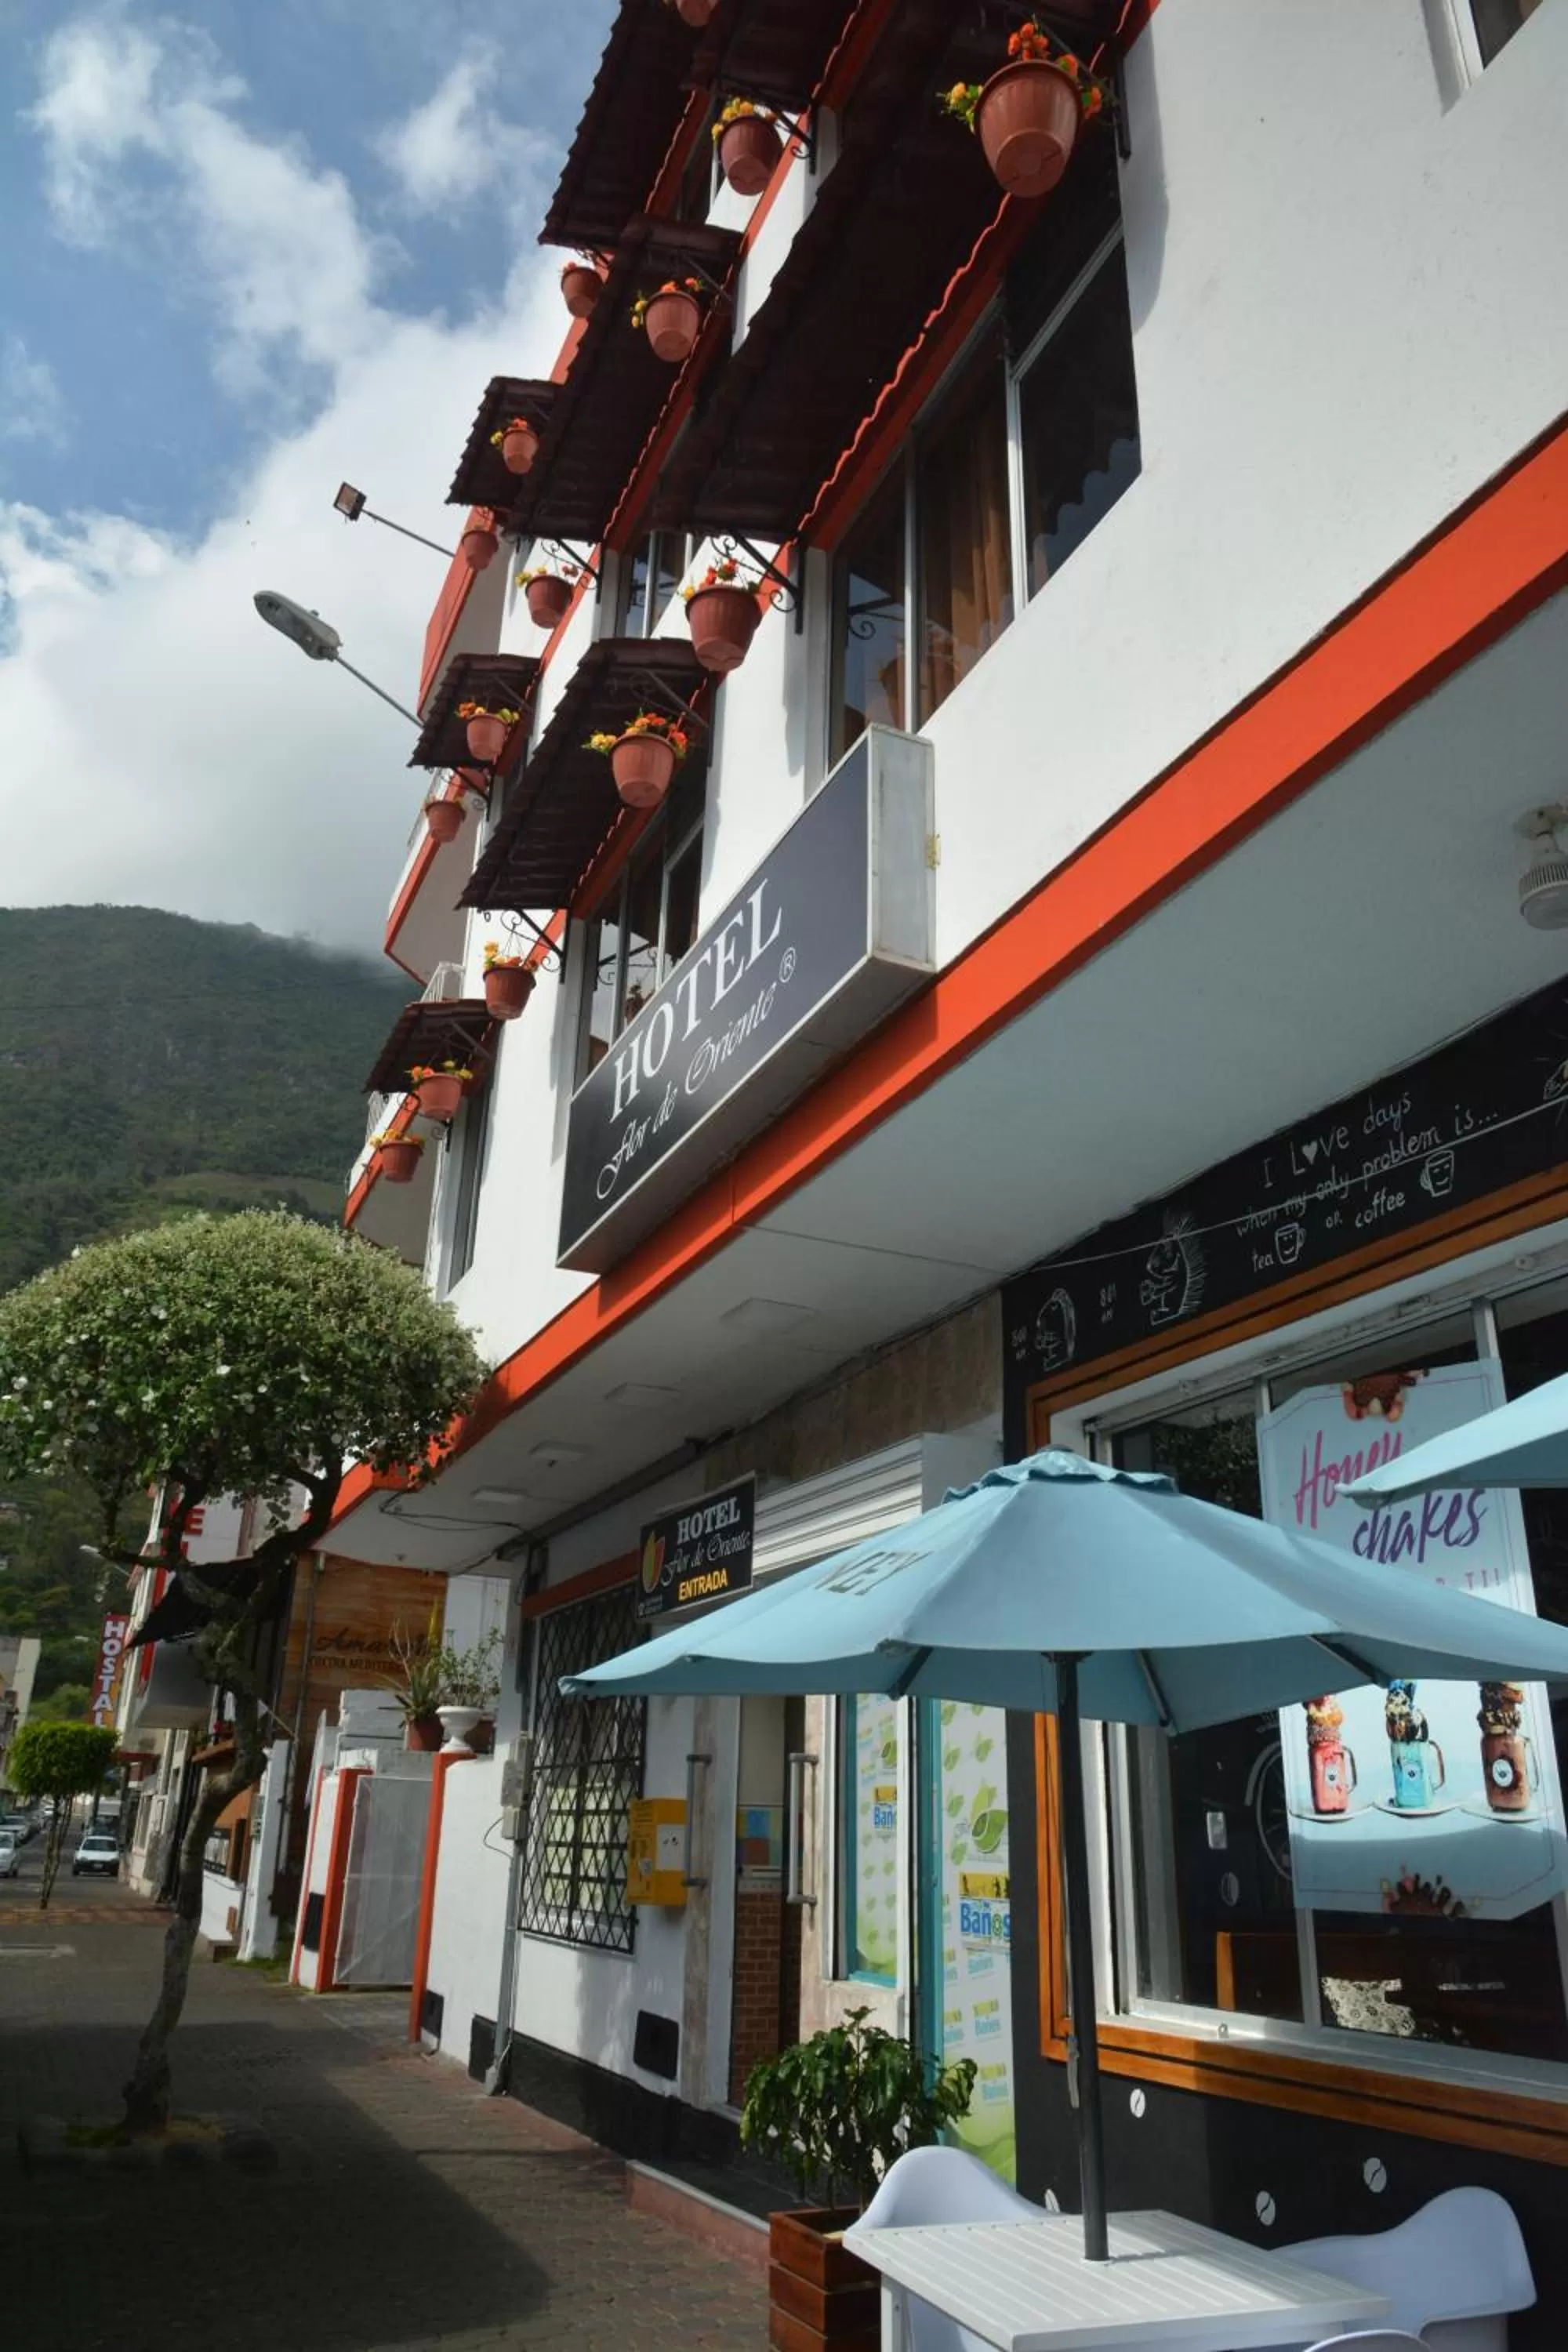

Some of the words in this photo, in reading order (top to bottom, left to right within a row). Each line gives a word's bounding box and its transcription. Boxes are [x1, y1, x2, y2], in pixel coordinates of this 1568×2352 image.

[610, 877, 782, 1123] HOTEL
[652, 1080, 678, 1134] de
[685, 981, 777, 1094] Oriente
[1262, 1157, 1274, 1189] I
[1363, 1092, 1411, 1135] days
[1316, 1165, 1350, 1200] only
[1363, 1126, 1442, 1192] problem
[1252, 1249, 1275, 1272] tea
[1355, 1186, 1406, 1228] coffee
[677, 1496, 740, 1545] HOTEL
[678, 1567, 728, 1601] ENTRADA
